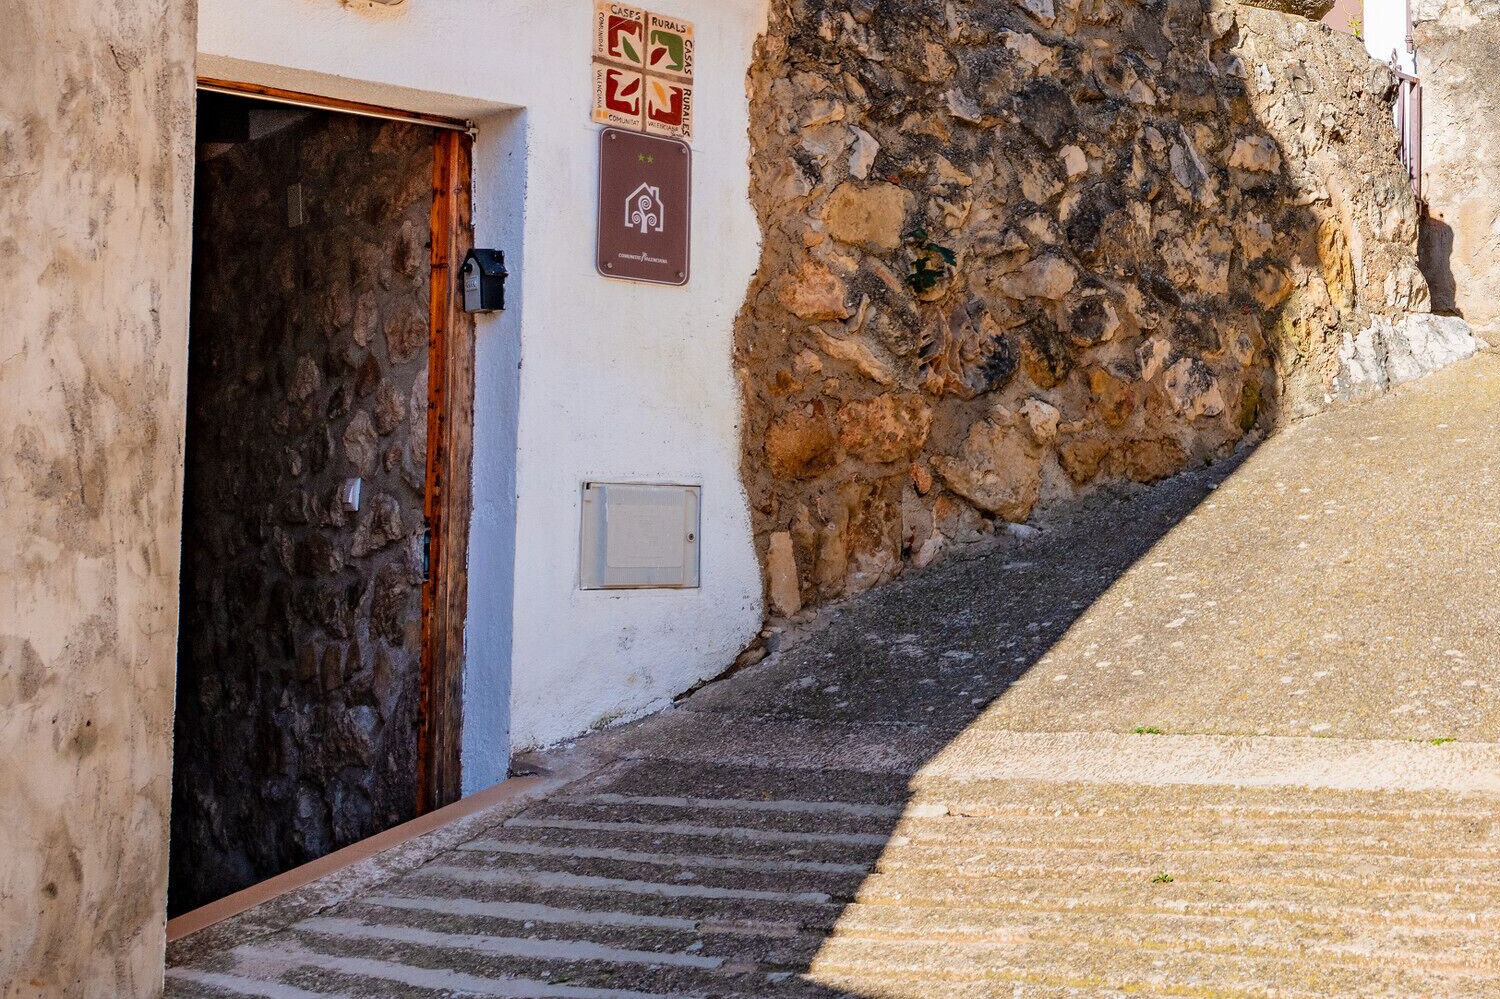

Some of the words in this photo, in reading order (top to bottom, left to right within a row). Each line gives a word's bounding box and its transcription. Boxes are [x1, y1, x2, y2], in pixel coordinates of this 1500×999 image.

[611, 4, 641, 20] CASES
[652, 16, 686, 33] RURALS
[684, 39, 693, 75] CASAS
[608, 114, 640, 126] COMUNITAT
[648, 121, 679, 132] VALENCIANA
[681, 88, 692, 137] RURALES
